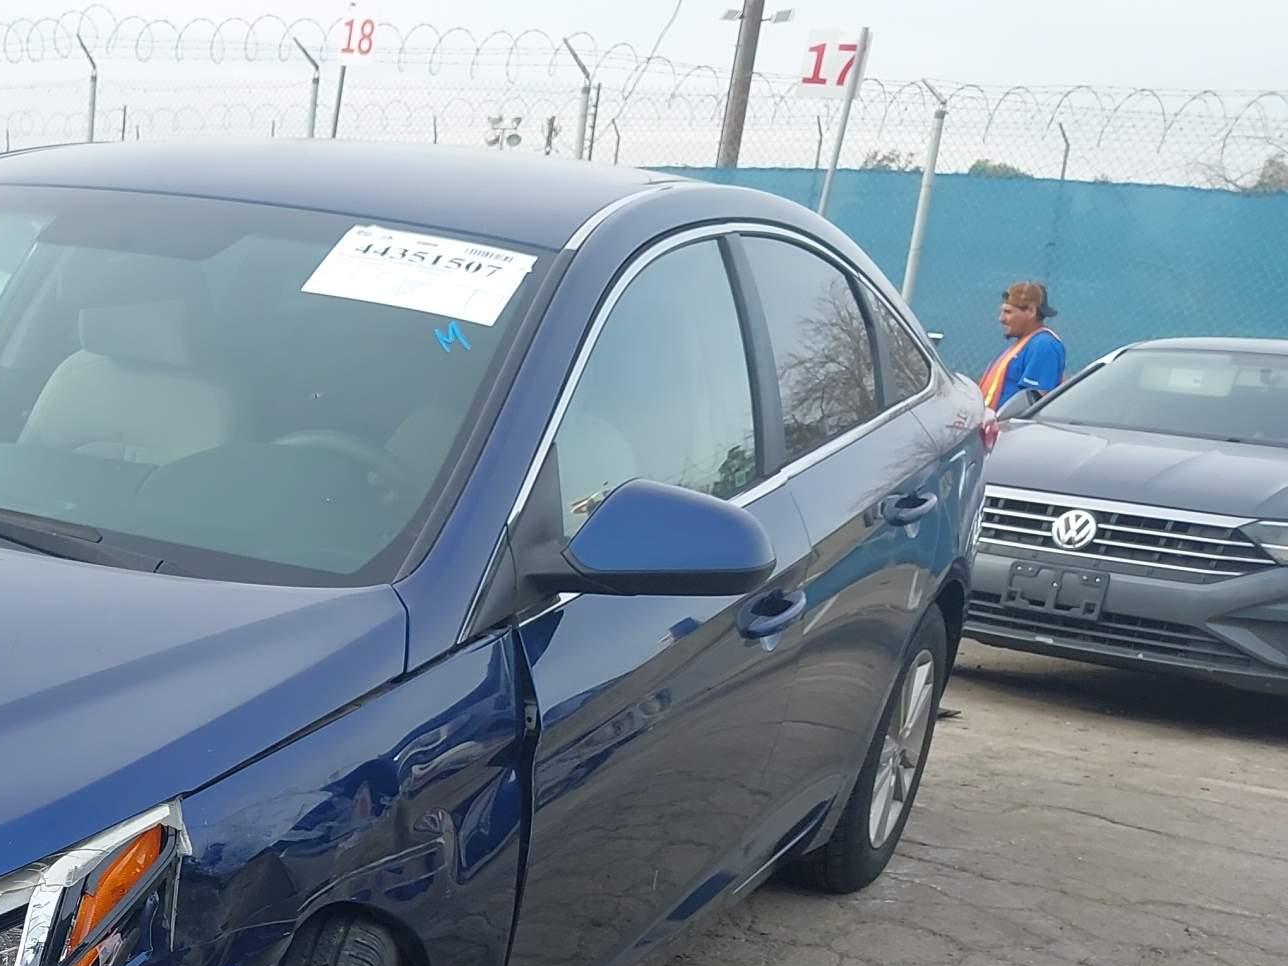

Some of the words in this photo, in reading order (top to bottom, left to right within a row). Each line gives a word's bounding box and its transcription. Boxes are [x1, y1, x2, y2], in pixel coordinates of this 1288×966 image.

[341, 18, 376, 55] 18
[801, 43, 859, 87] 17
[355, 243, 504, 278] 44351507
